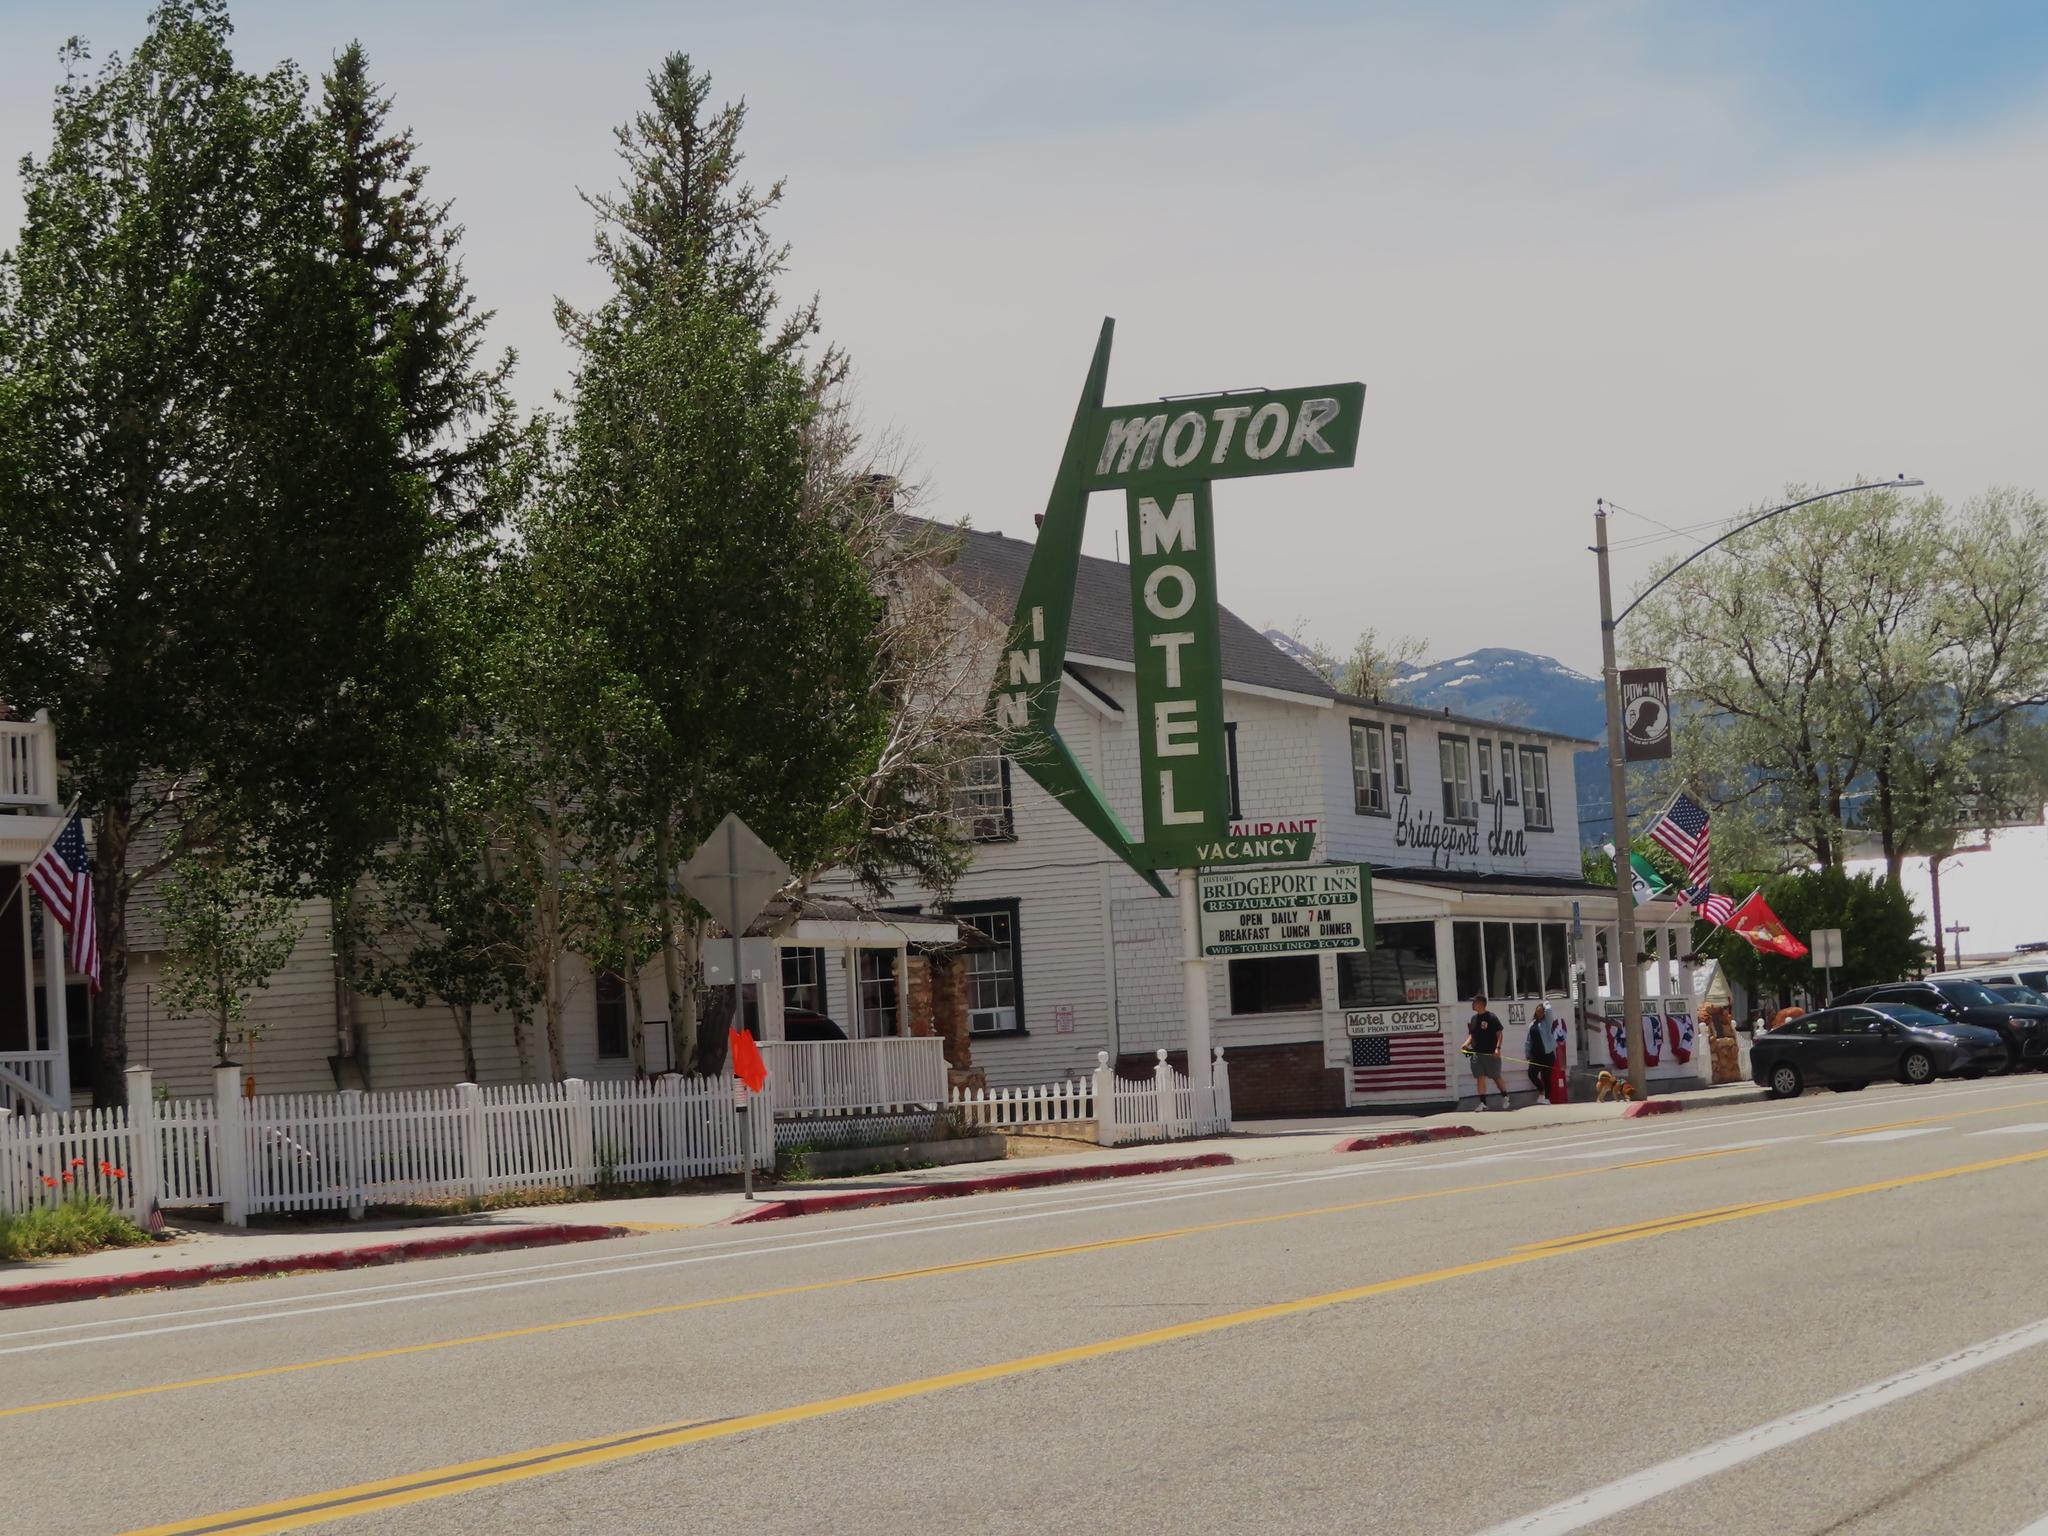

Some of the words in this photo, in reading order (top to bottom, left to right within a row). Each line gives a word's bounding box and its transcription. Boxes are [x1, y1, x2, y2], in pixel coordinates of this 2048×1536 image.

[1096, 398, 1340, 475] MOTOR
[996, 606, 1045, 728] INN
[1138, 493, 1205, 826] MOTEL
[1623, 683, 1644, 709] POW
[1648, 681, 1668, 707] MIA
[1396, 795, 1480, 869] Bridgeport
[1488, 789, 1528, 857] Inn
[1196, 838, 1298, 860] VACANCY
[1203, 875, 1236, 884] HISTORIC
[1335, 867, 1357, 876] 1877
[1203, 875, 1318, 899] BRIDGEPORT
[1323, 877, 1358, 891] INN
[1209, 896, 1298, 911] RESTAURANT
[1307, 893, 1354, 906] MOTEL
[1240, 914, 1263, 926] OPEN
[1271, 911, 1298, 924] DAILY
[1308, 910, 1314, 922] 7
[1317, 910, 1331, 921] AM
[1219, 927, 1270, 942] BREAKFAST
[1281, 925, 1310, 938] LUNCH
[1320, 923, 1352, 936] DINNER
[1241, 943, 1285, 952] TOURIST
[1287, 941, 1312, 950] INFO
[1407, 986, 1436, 1001] OPEN
[1349, 1013, 1384, 1026] Motel
[1391, 1011, 1436, 1024] Office
